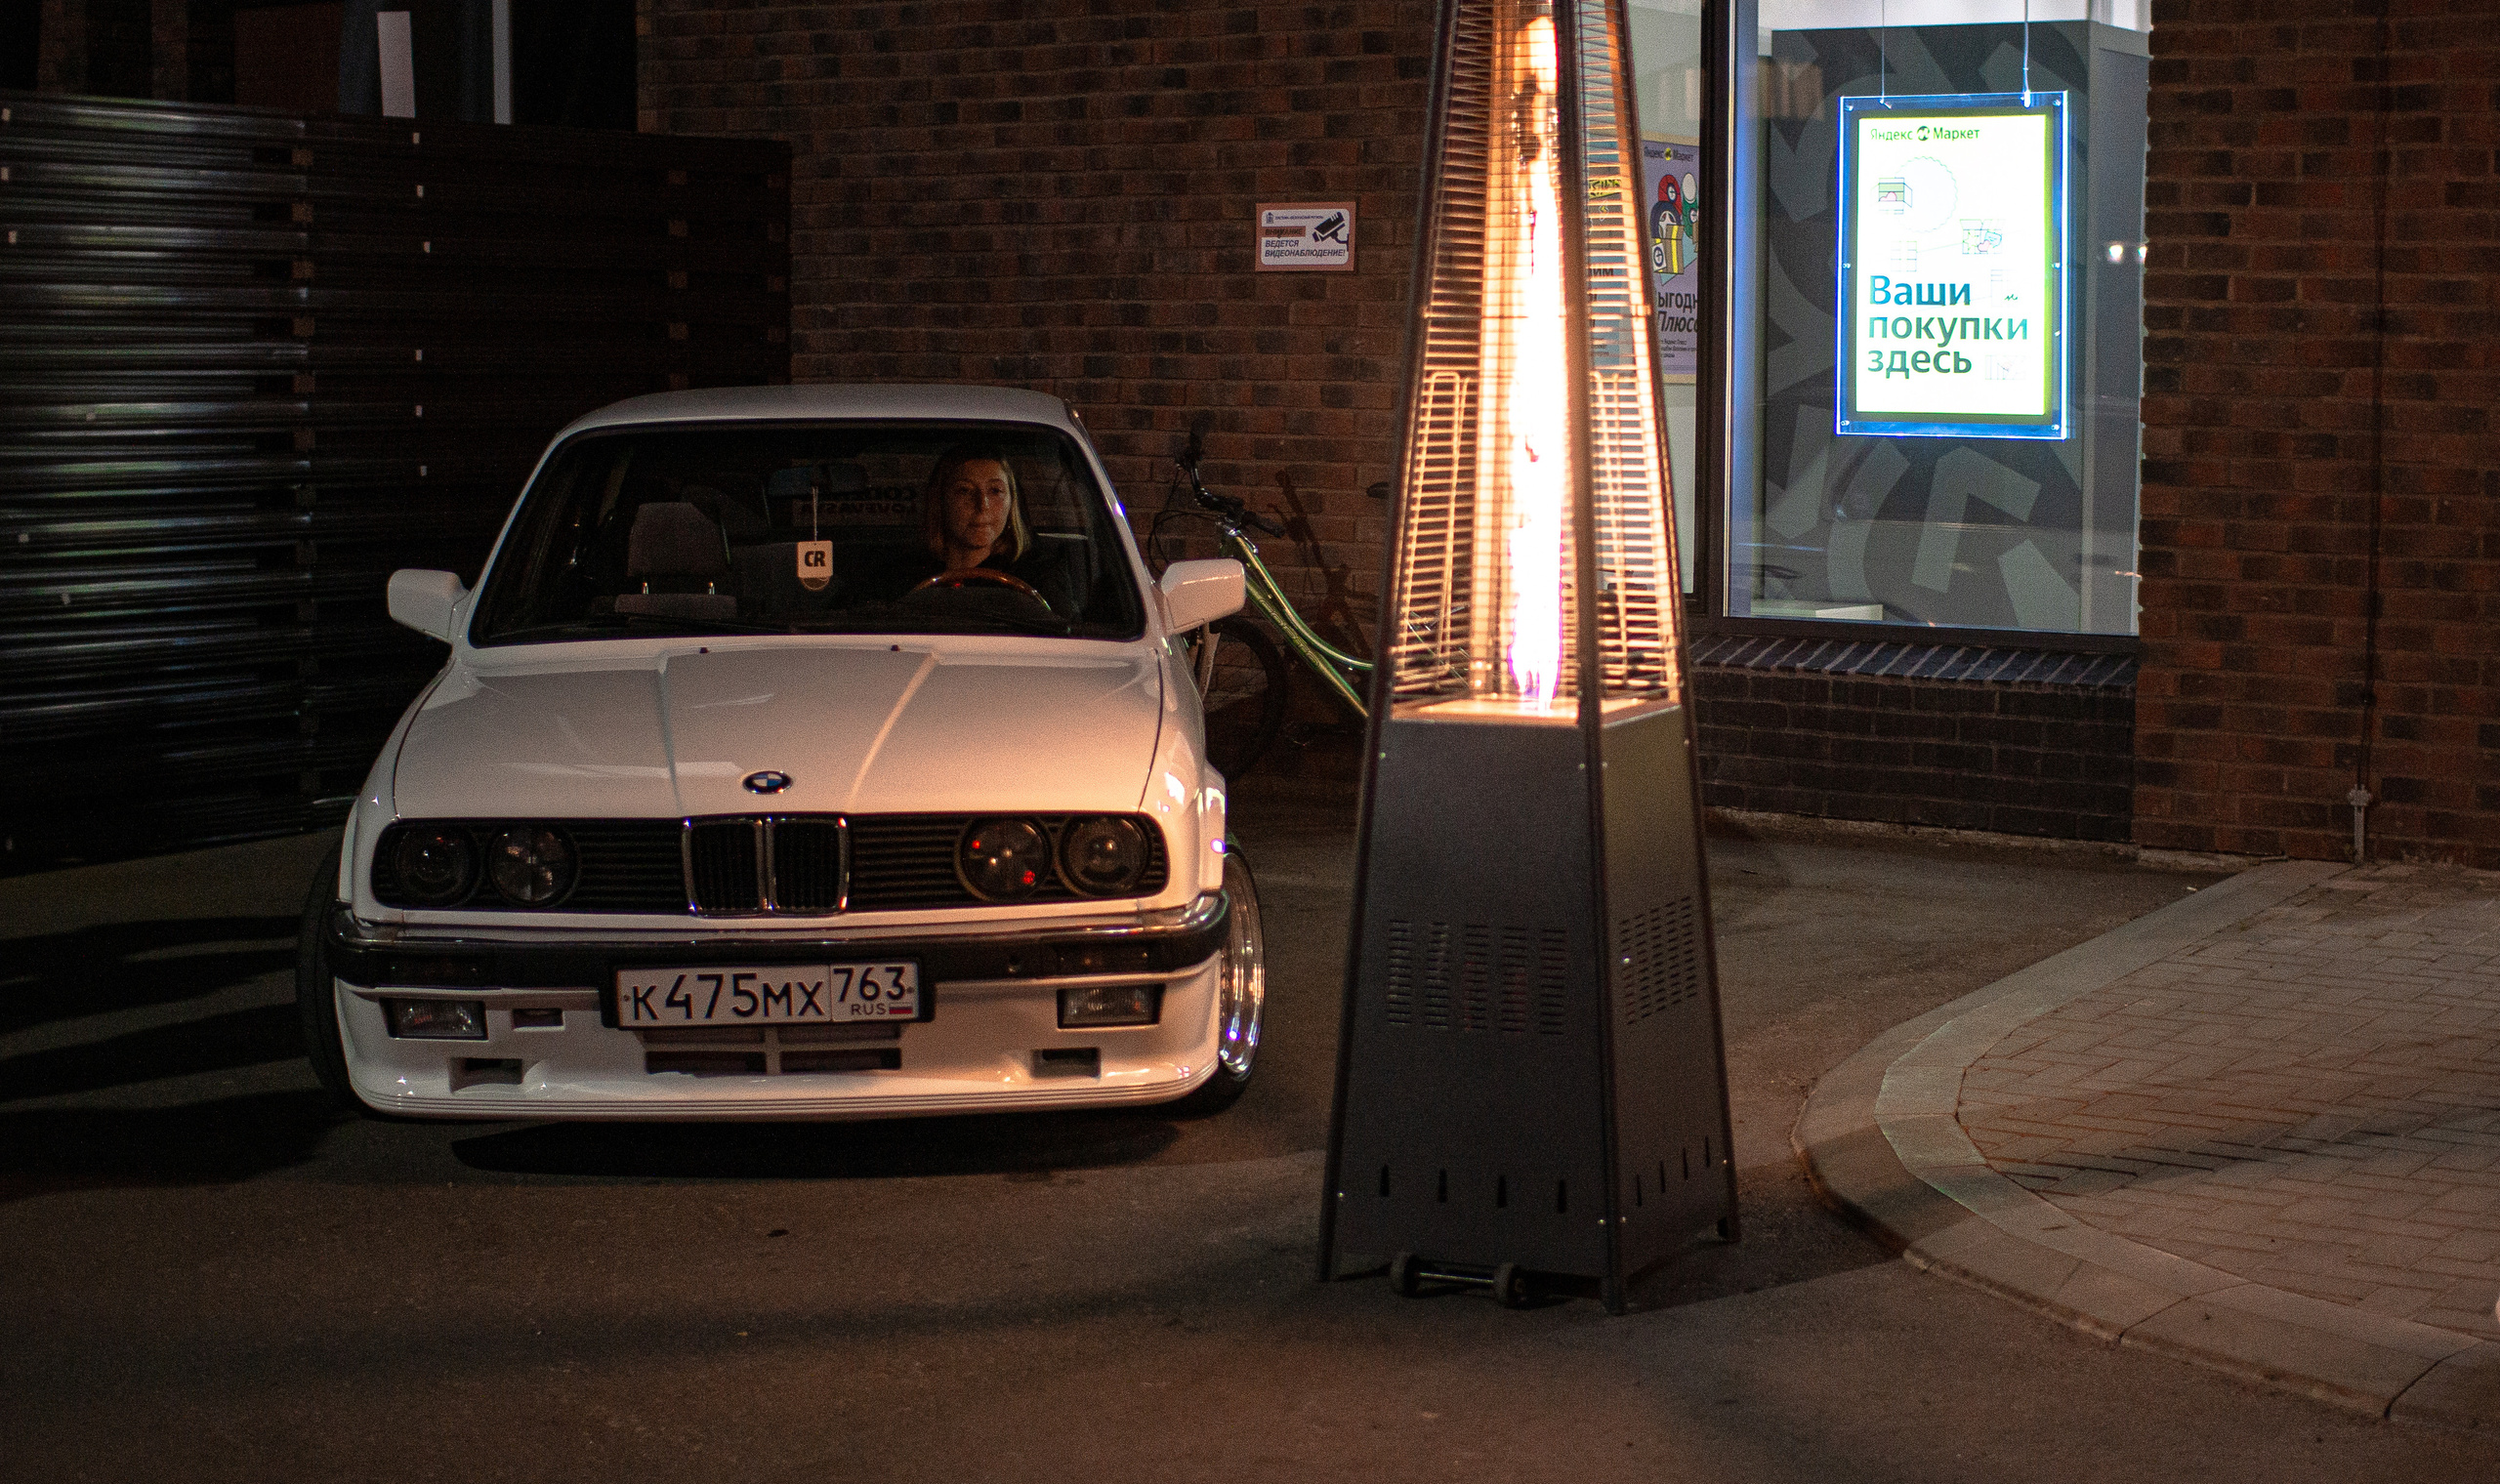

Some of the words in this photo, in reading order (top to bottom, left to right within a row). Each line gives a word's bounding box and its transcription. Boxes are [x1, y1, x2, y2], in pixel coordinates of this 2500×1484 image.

[1870, 128, 1913, 142] Яндекс
[1934, 127, 1980, 142] Маркет
[1869, 274, 1972, 307] Ваши
[1868, 315, 2028, 348] покупки
[1867, 350, 1973, 380] здесь
[804, 550, 826, 567] CR
[833, 967, 907, 1003] 763
[851, 1003, 887, 1015] RUS
